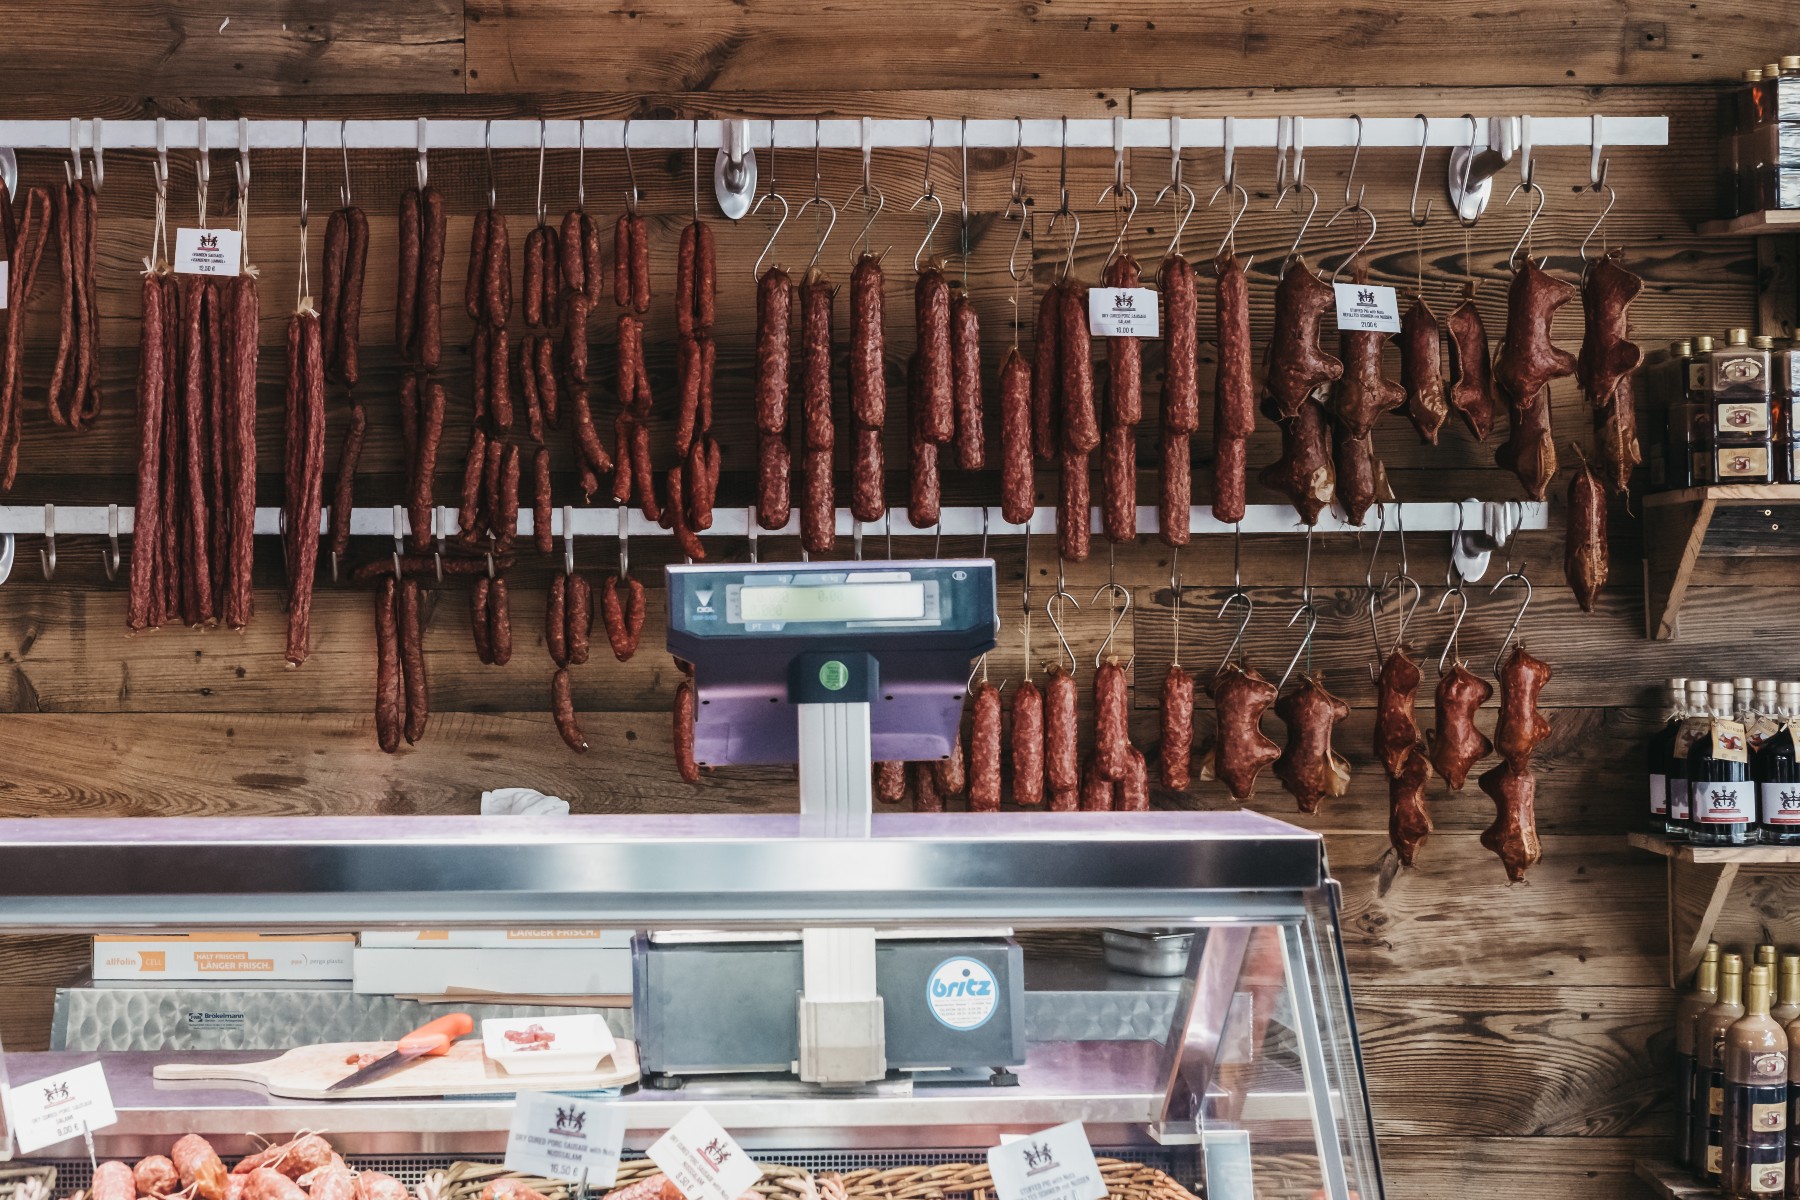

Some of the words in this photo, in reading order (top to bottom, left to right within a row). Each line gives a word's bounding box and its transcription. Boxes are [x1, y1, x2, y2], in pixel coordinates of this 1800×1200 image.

[106, 958, 136, 966] allfolin
[200, 960, 236, 969] LÄNGER
[933, 968, 991, 997] britz
[528, 1135, 546, 1146] CURED
[563, 1142, 588, 1152] SAUSAGE
[572, 1166, 579, 1177] €
